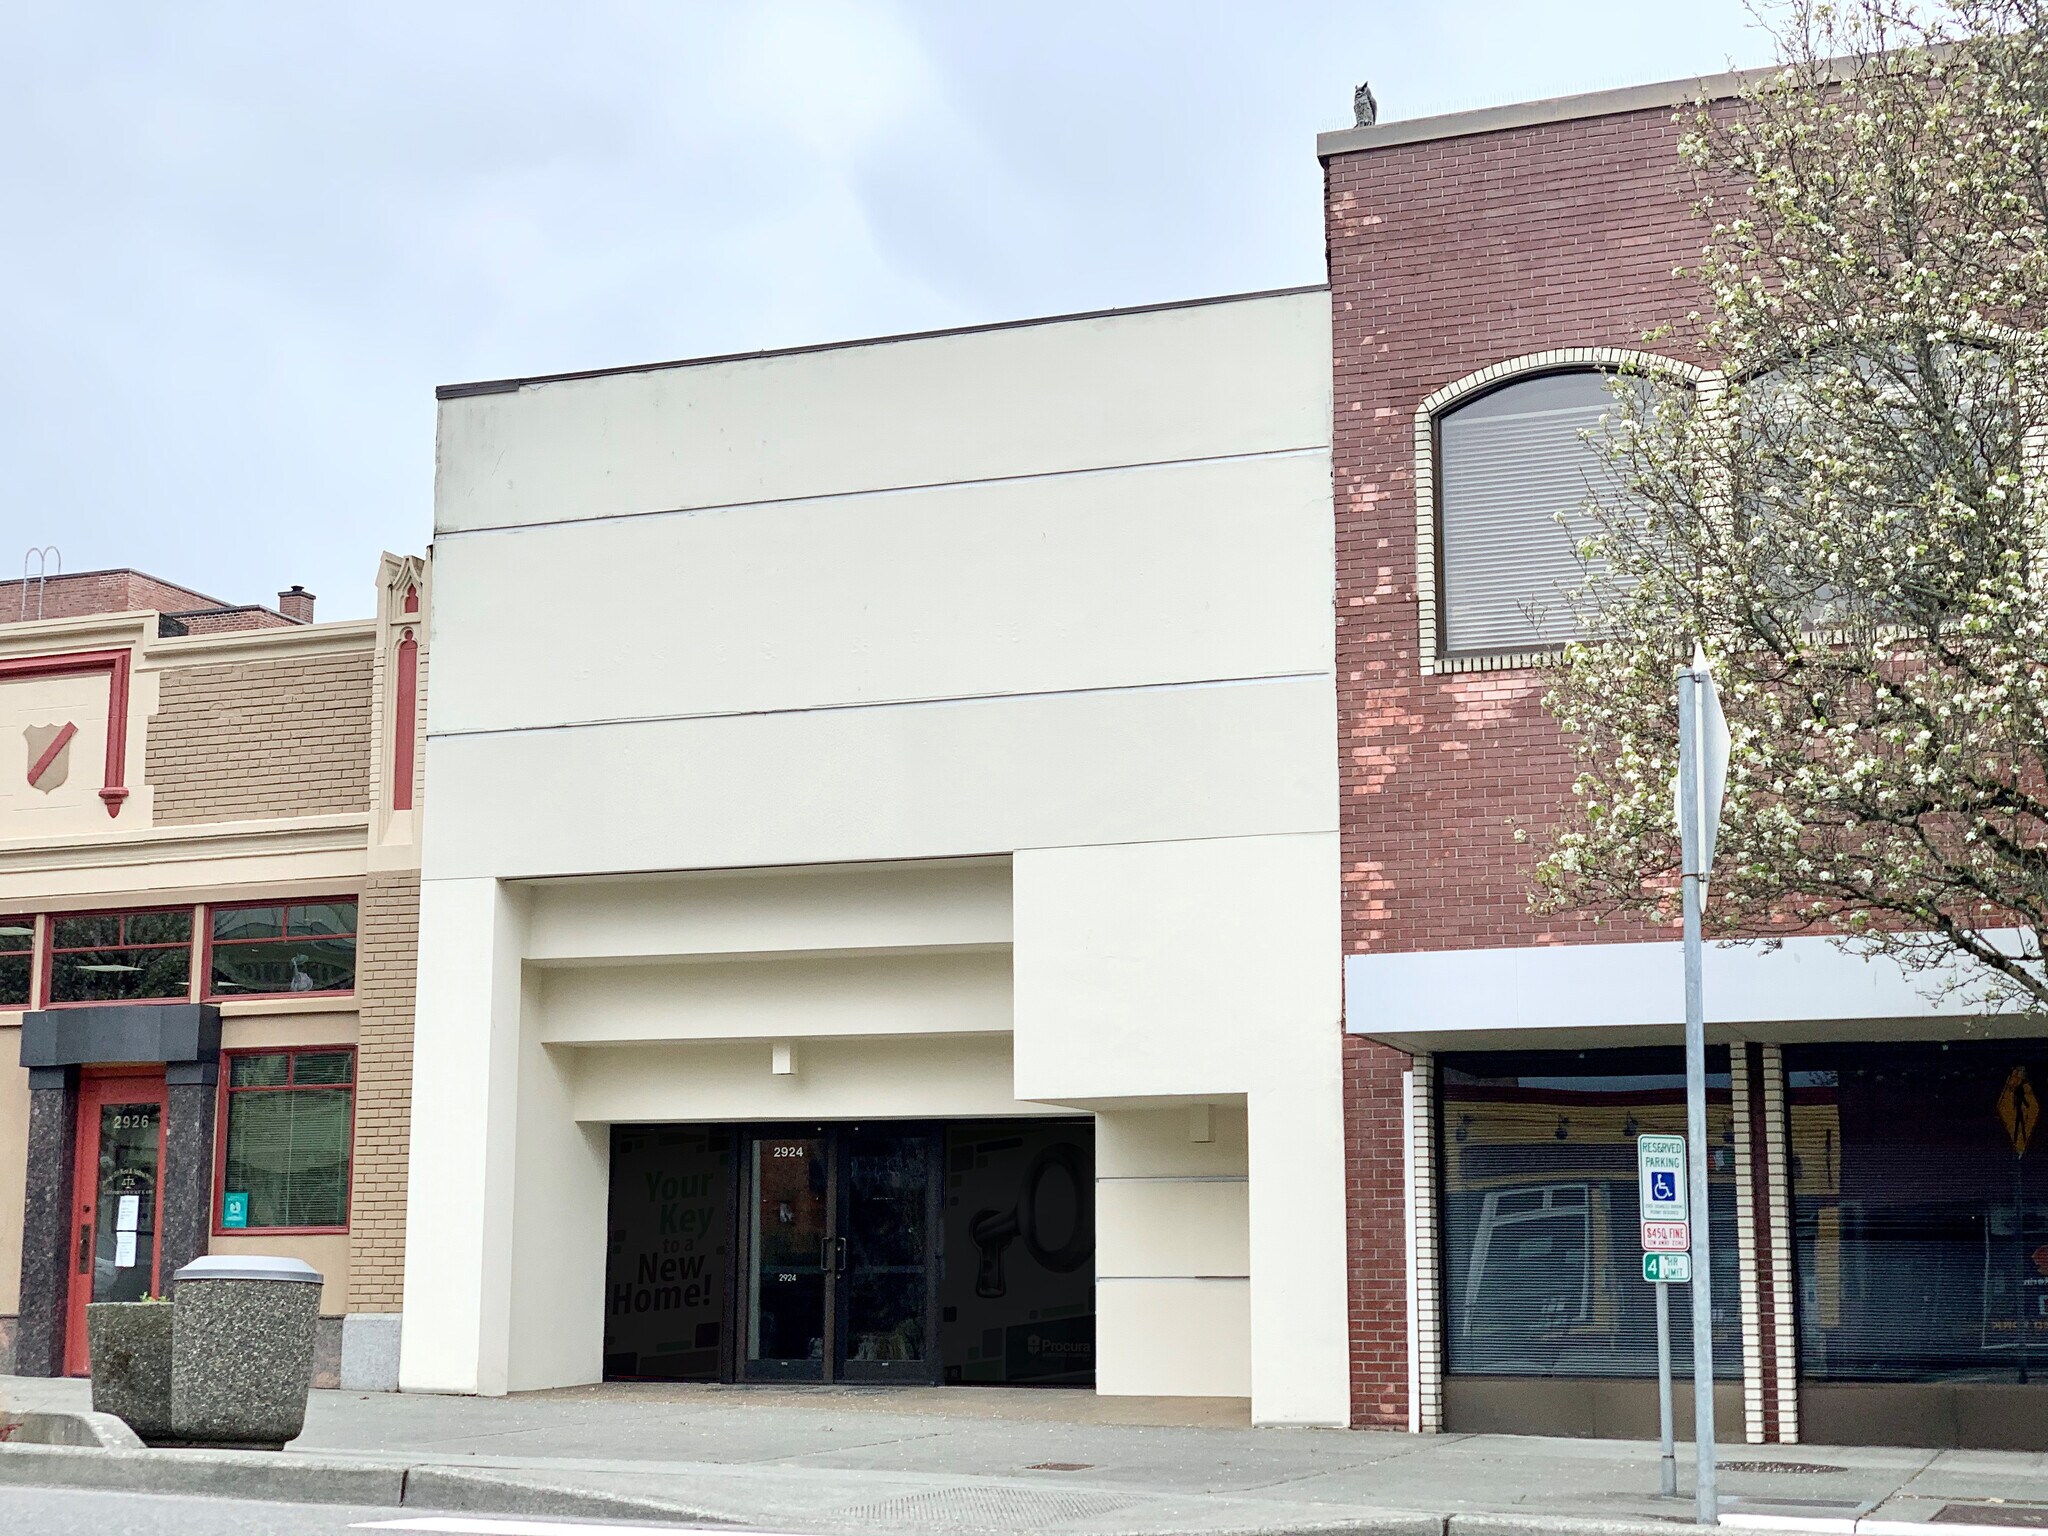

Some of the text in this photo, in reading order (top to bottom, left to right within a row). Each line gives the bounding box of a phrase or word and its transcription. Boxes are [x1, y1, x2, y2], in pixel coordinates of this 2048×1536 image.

[113, 1115, 149, 1129] 2926
[773, 1147, 804, 1158] 2924
[1642, 1142, 1682, 1154] RESERVED
[1645, 1156, 1680, 1168] PARKING
[645, 1171, 714, 1202] Your
[660, 1203, 714, 1240] Key
[1647, 1227, 1685, 1239] $450 FINE
[662, 1238, 694, 1254] to a
[638, 1252, 705, 1284] New
[1647, 1258, 1658, 1275] 4
[1667, 1257, 1679, 1266] HR
[778, 1273, 797, 1282] 2924
[1663, 1267, 1683, 1277] LIMIT
[612, 1274, 712, 1315] Home!
[1042, 1339, 1091, 1352] Procura
